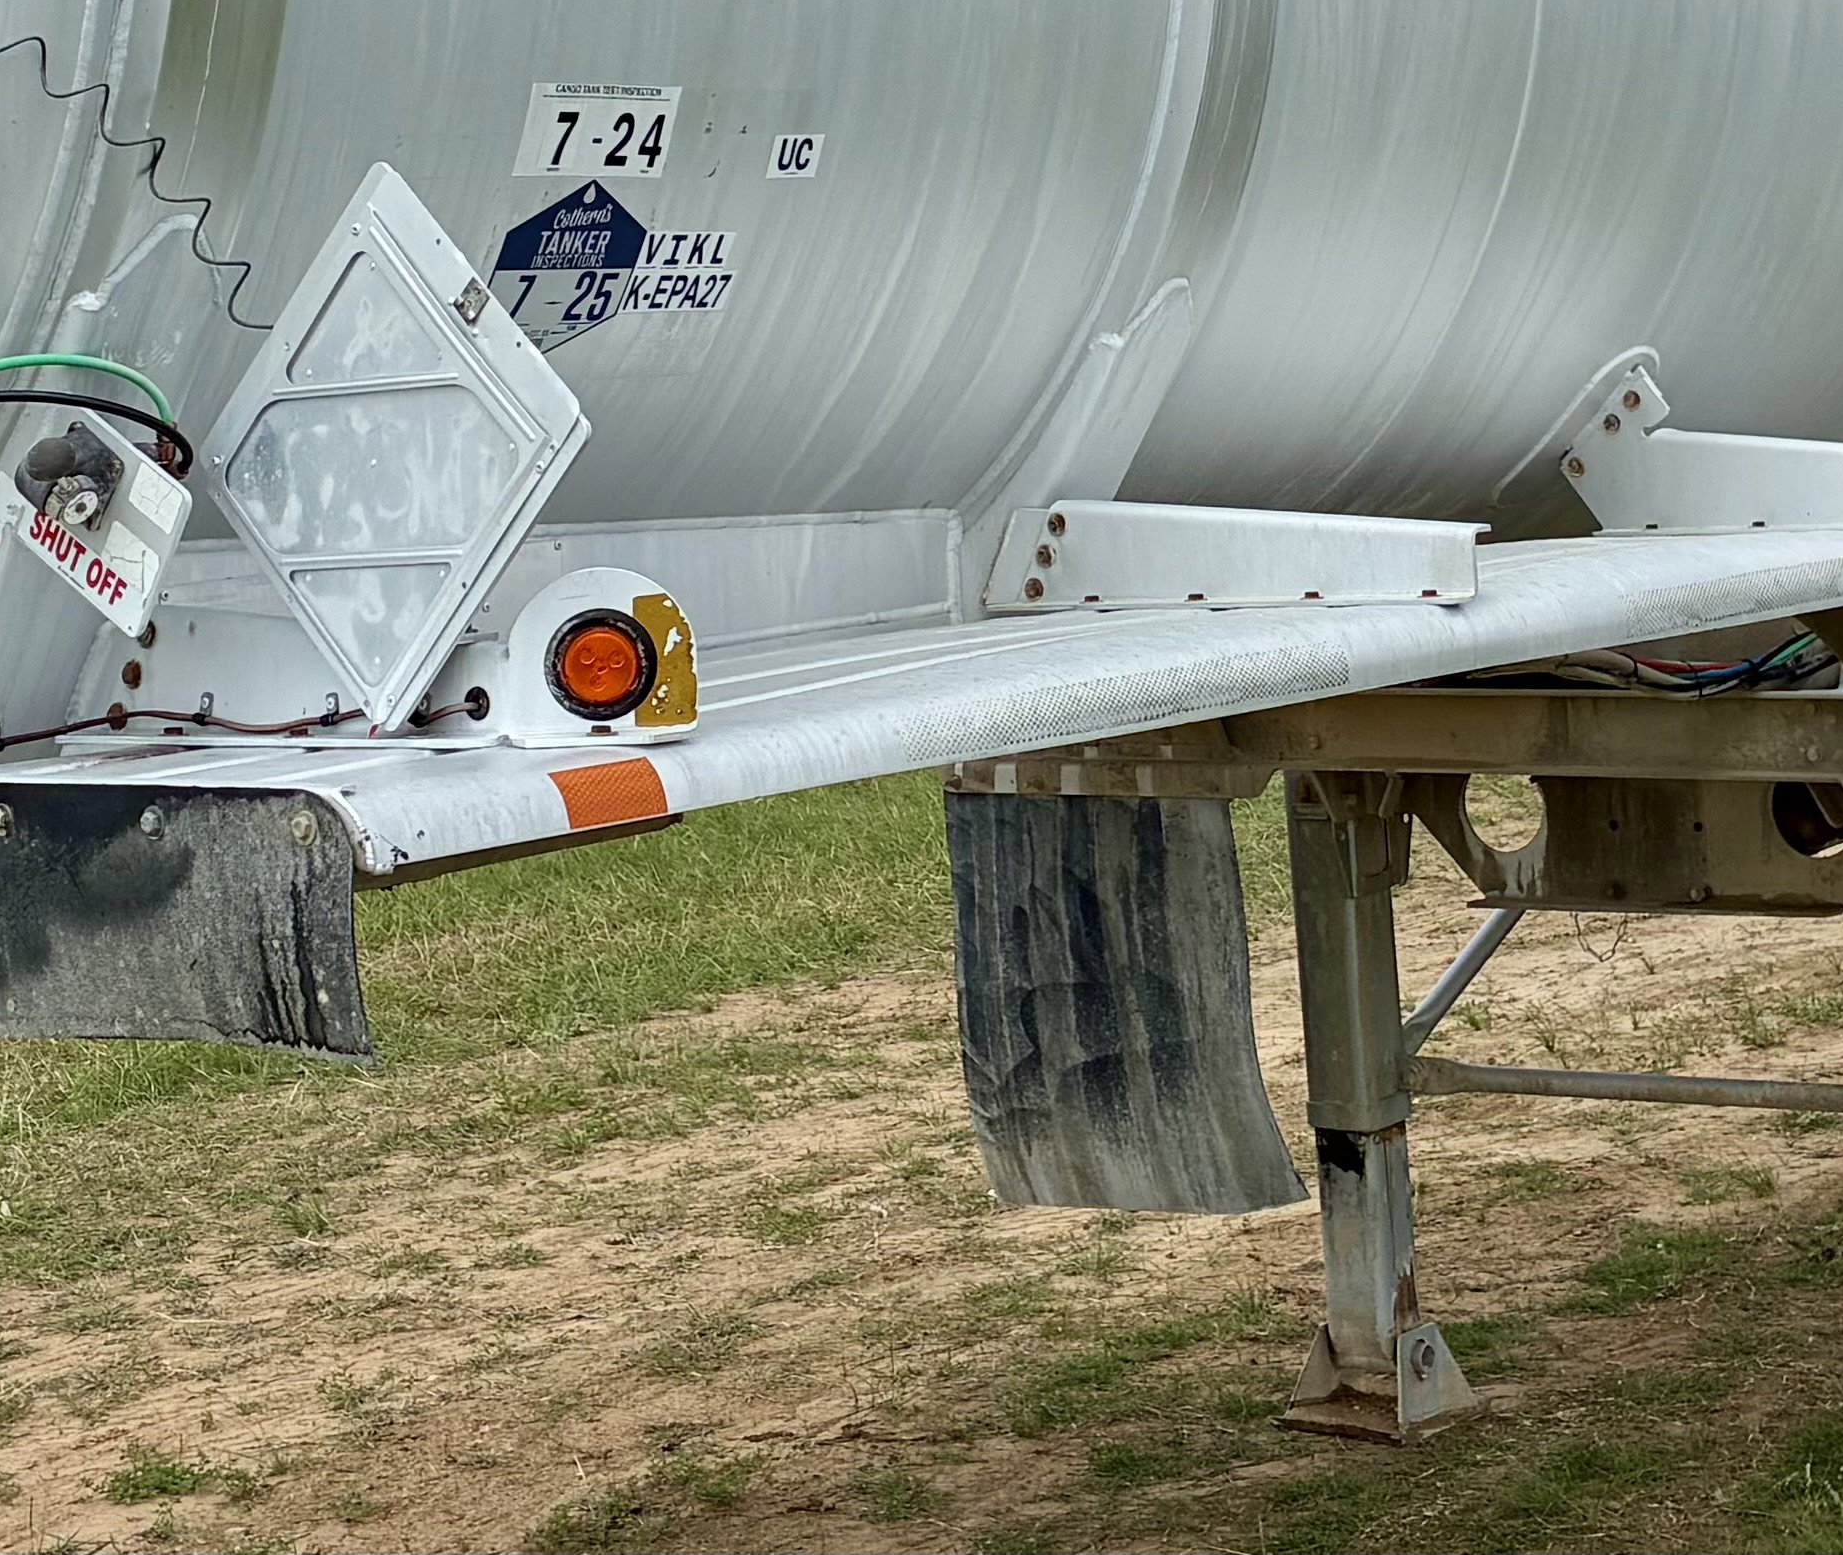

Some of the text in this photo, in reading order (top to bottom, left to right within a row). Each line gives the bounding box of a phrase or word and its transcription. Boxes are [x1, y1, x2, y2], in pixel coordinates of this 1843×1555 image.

[777, 138, 813, 171] UC
[538, 231, 612, 255] TANKER
[645, 233, 725, 266] VIKL
[530, 254, 606, 269] INSPECTIONS
[622, 273, 733, 310] K-EPA27
[29, 510, 128, 606] SHUT OFF
